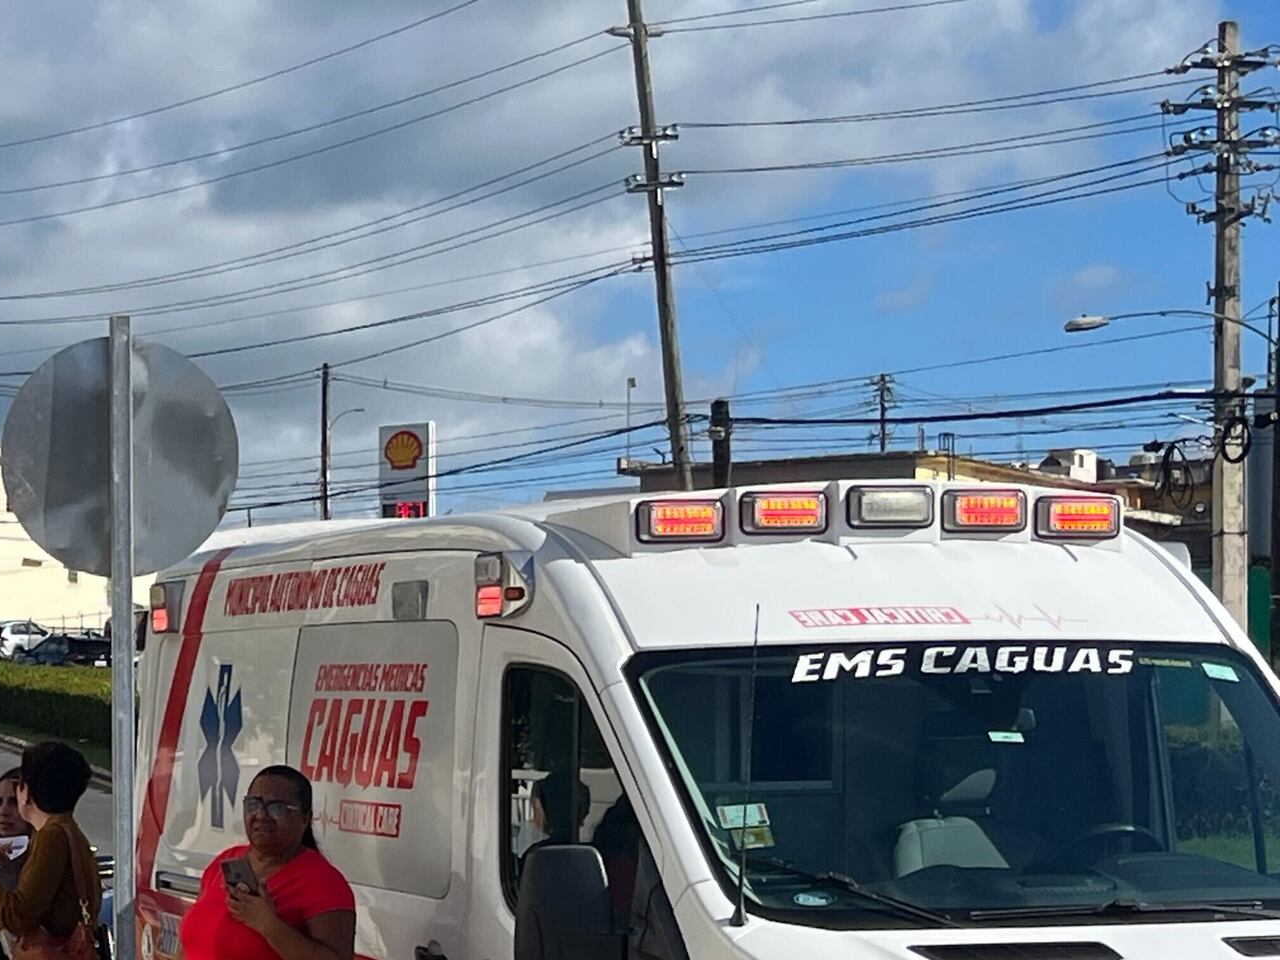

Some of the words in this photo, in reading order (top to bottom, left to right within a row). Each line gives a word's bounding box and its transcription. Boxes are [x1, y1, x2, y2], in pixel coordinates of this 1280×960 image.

[337, 563, 386, 606] CAGUAS
[791, 648, 907, 683] EMS
[921, 646, 1134, 675] CAGUAS
[300, 698, 429, 789] CAGUAS
